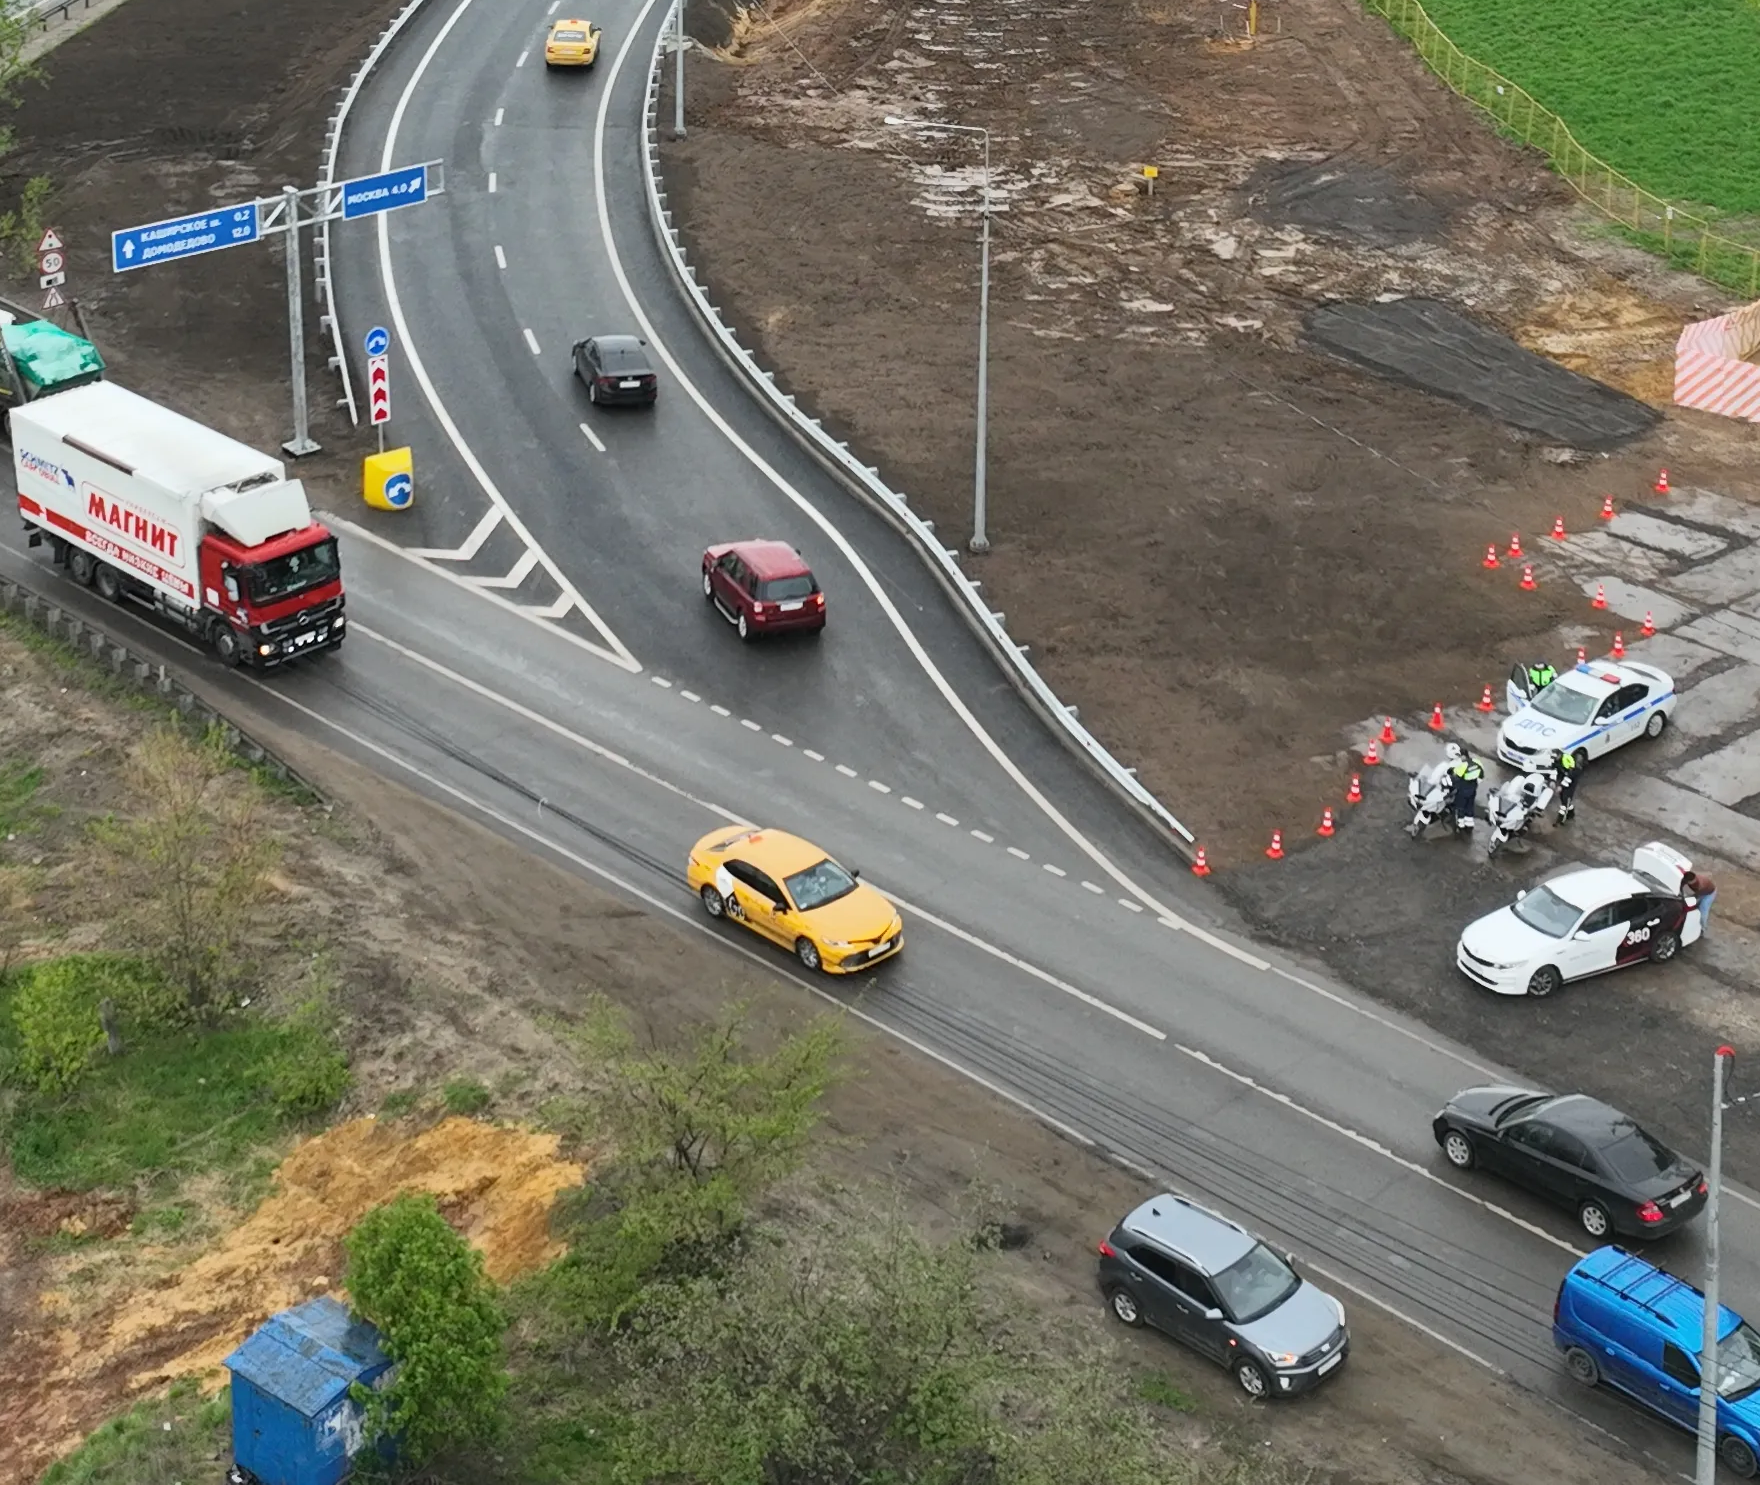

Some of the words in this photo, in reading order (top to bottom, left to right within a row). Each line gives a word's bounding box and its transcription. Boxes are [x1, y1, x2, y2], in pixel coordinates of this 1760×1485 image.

[347, 187, 390, 206] МОСКВА
[391, 182, 408, 194] 4.0
[141, 219, 208, 243] КАШИРСКОЕ
[142, 233, 216, 260] ДОМОДЕДОВО
[45, 257, 60, 268] 50
[88, 492, 178, 557] МАГНИТ
[1514, 718, 1556, 737] ДПС
[1627, 927, 1650, 945] 360
